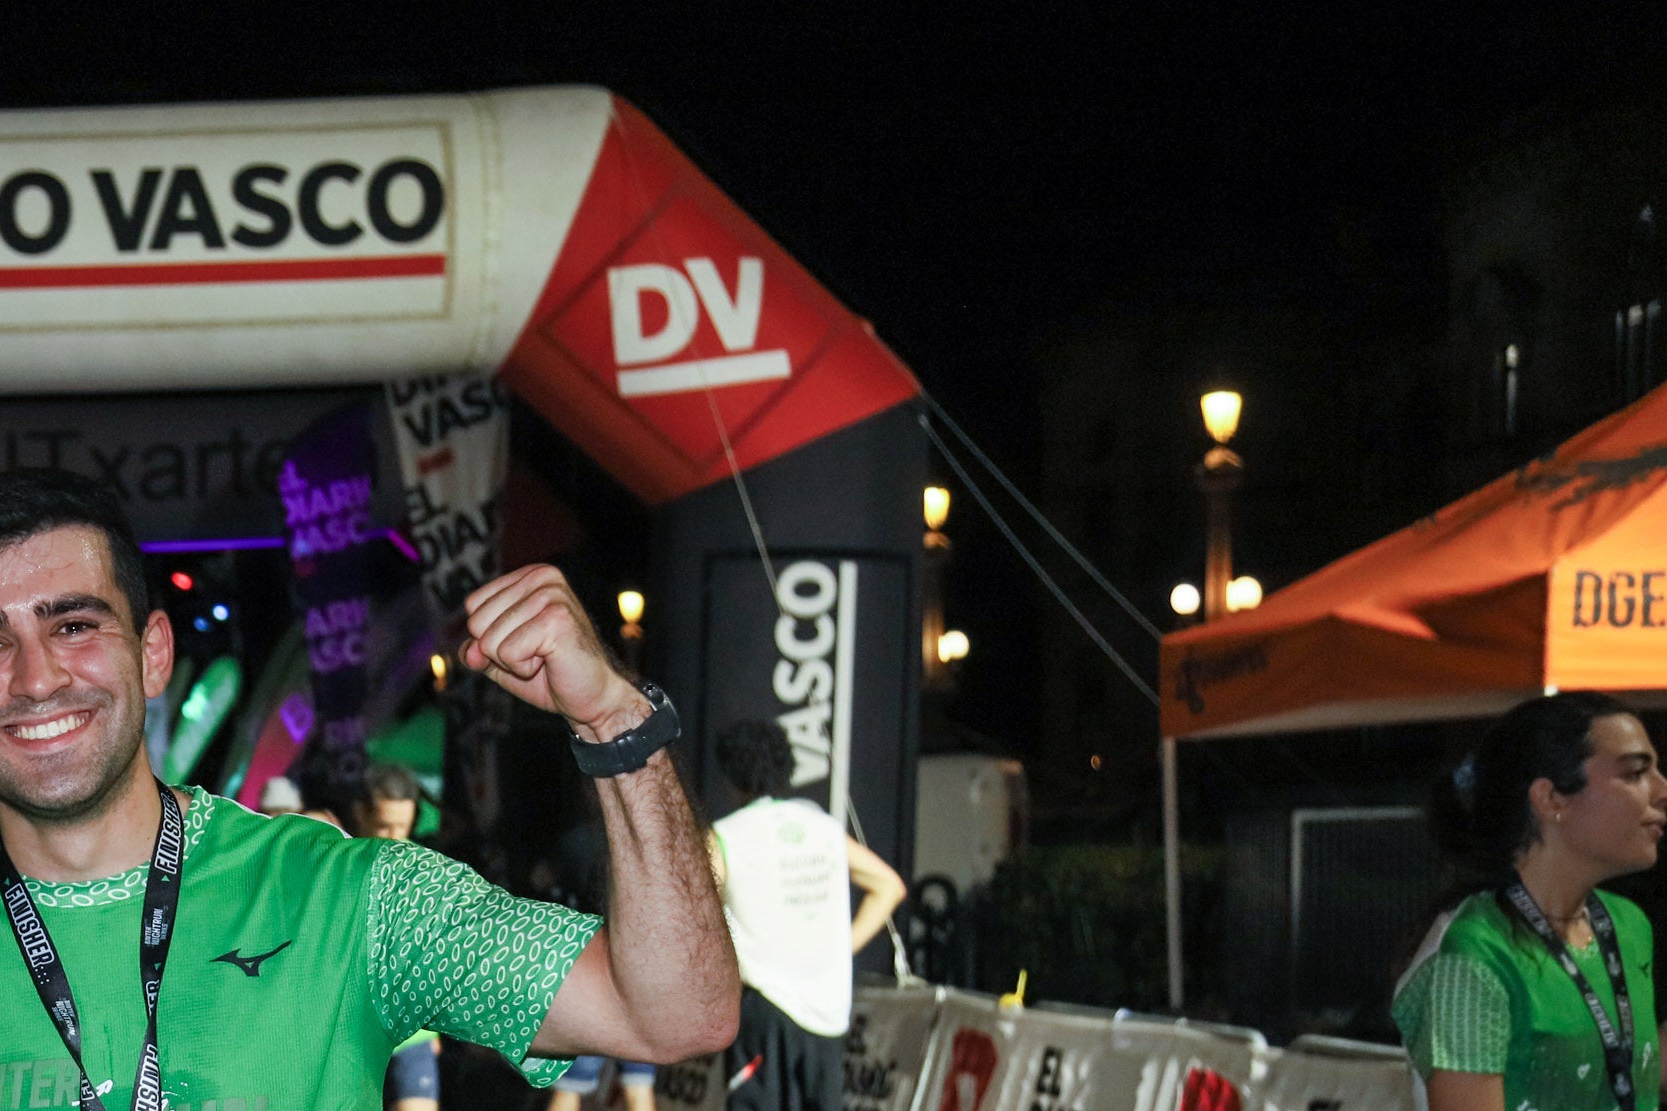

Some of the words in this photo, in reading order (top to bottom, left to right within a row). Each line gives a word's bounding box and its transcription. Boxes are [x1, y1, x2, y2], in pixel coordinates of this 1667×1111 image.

[90, 157, 446, 253] VASCO
[608, 256, 765, 365] DV
[773, 560, 837, 787] VASCO
[4, 883, 54, 968] FINISHER
